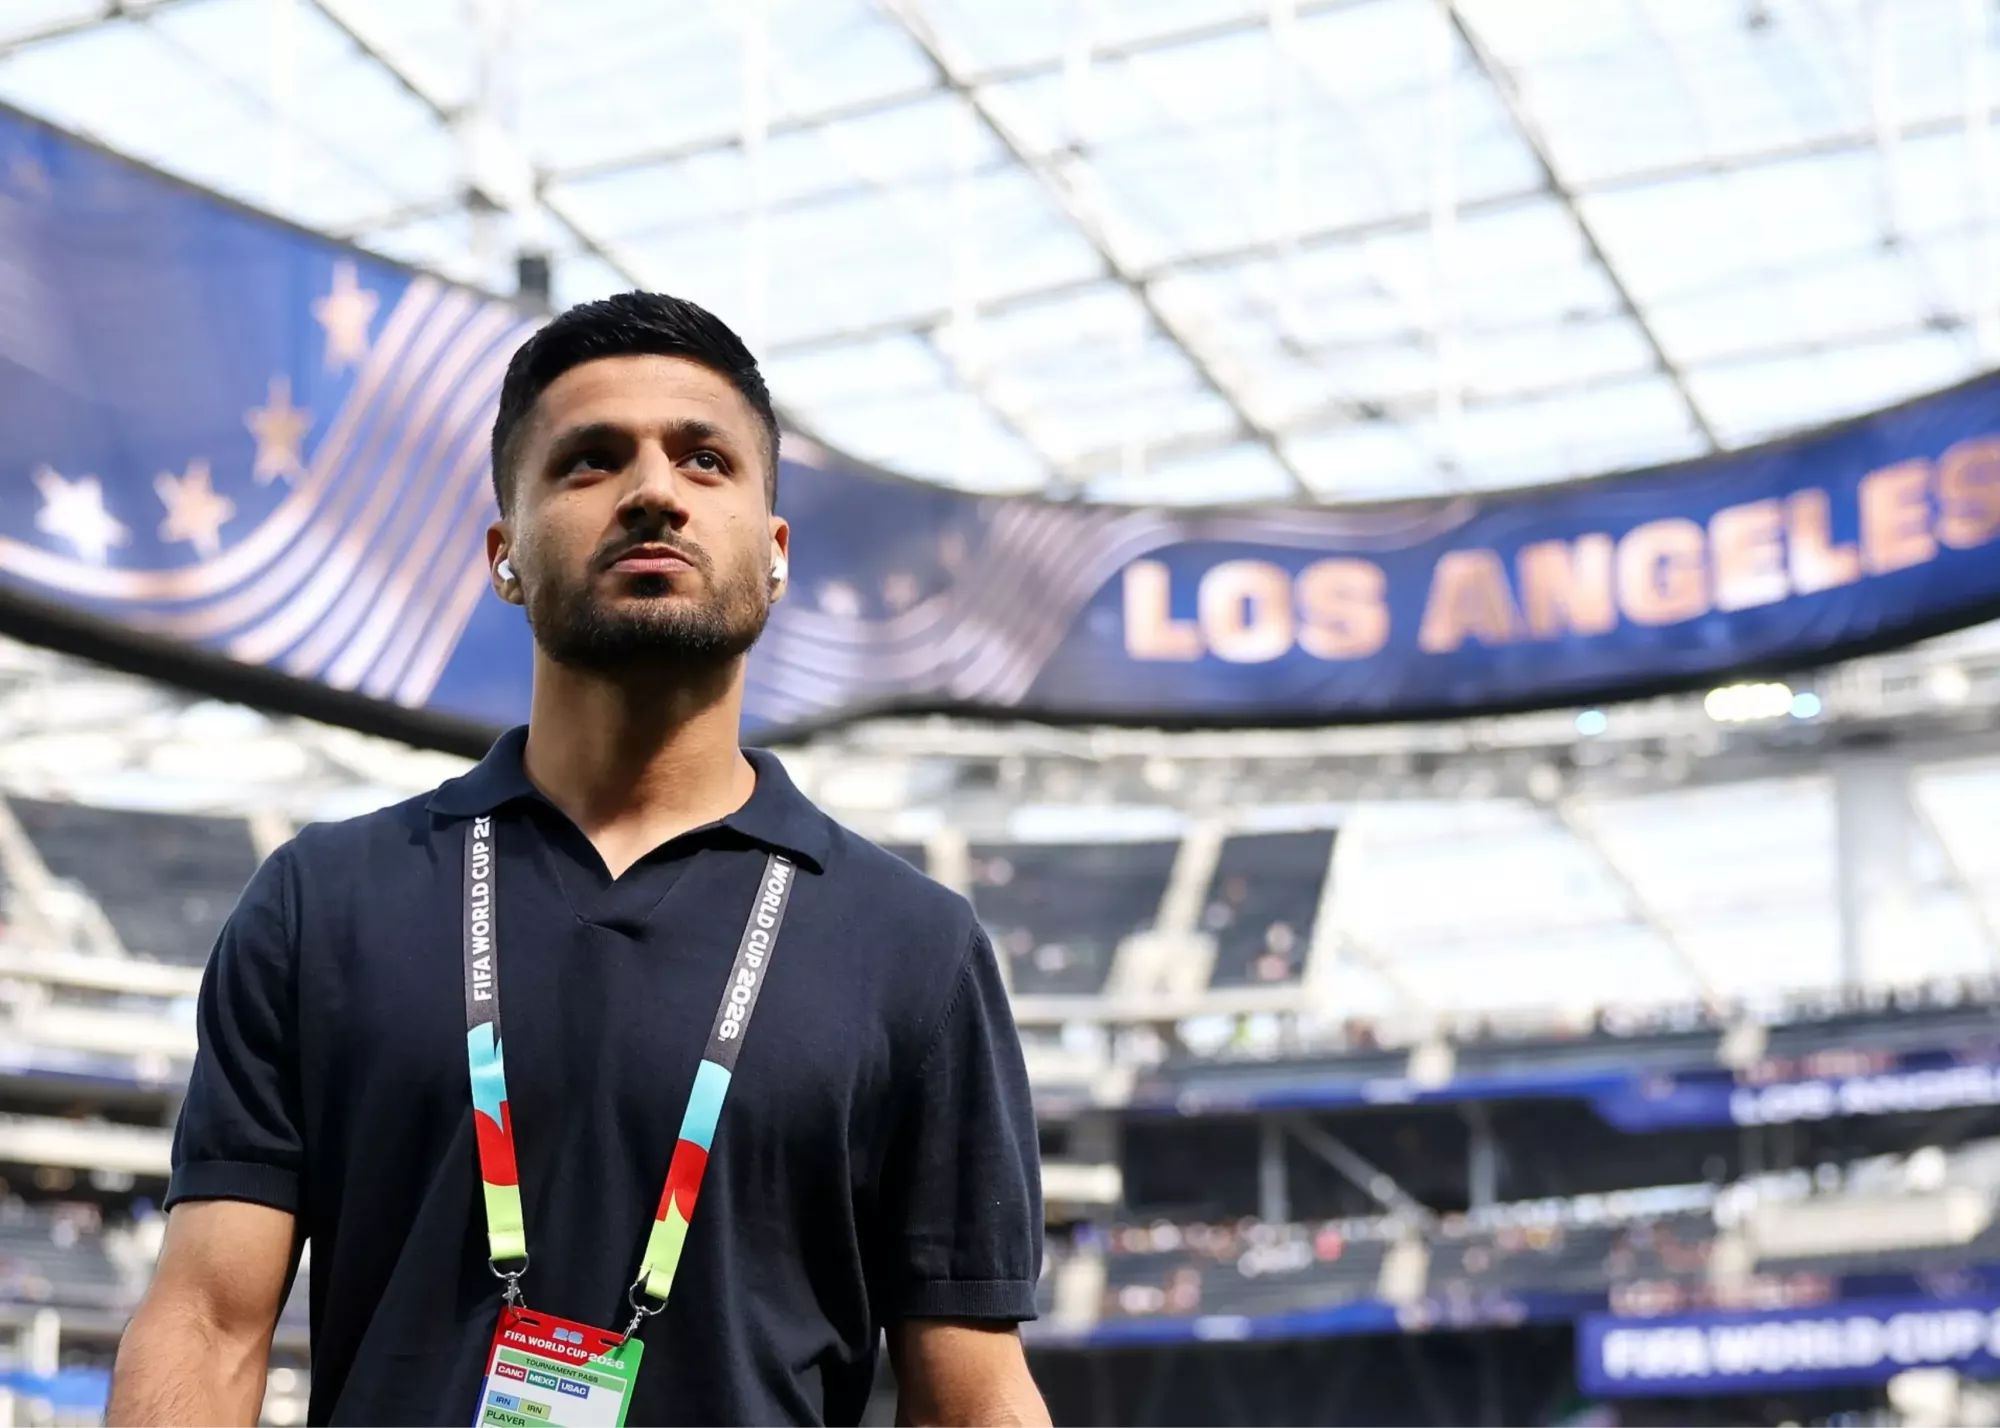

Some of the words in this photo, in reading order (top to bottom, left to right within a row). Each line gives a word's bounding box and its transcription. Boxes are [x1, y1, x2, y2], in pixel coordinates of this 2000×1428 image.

[1122, 557, 1391, 664] LOS
[1416, 433, 2000, 655] ANGELES
[471, 841, 490, 880] CUP
[757, 862, 790, 929] WORLD
[471, 882, 491, 956] WORLD
[744, 929, 770, 968] CUP
[472, 955, 493, 1002] FIFA
[719, 967, 757, 1040] 2026
[504, 1330, 527, 1344] FIFA
[528, 1337, 565, 1354] WORLD
[566, 1346, 588, 1360] CUP
[588, 1353, 625, 1370] 2026
[498, 1365, 524, 1379] CANC
[529, 1373, 556, 1387] MEXC
[561, 1382, 587, 1396] USAC
[526, 1358, 577, 1379] TOURNAMENT
[578, 1371, 599, 1383] PASS
[486, 1409, 525, 1427] PLAYER
[496, 1395, 511, 1406] IRN
[527, 1404, 542, 1414] IRN
